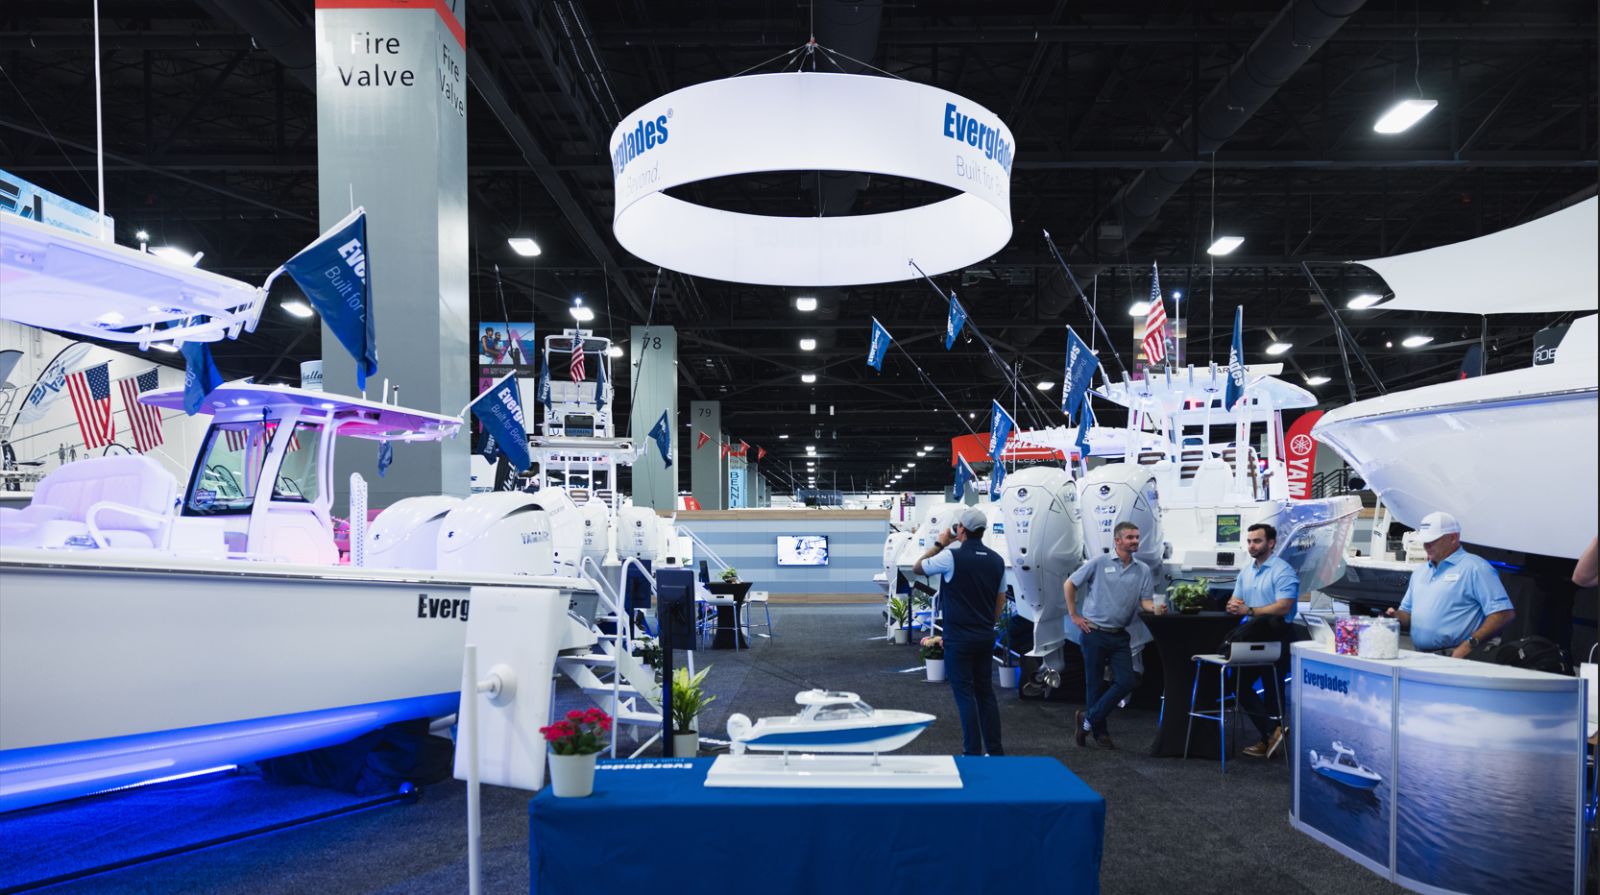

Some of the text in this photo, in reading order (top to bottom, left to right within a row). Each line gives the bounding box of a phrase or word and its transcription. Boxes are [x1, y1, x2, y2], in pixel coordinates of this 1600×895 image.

[351, 32, 400, 54] Fire
[338, 64, 414, 86] Valve
[443, 44, 459, 82] Fire
[439, 68, 464, 117] Valve
[325, 265, 352, 298] Built
[642, 336, 662, 350] 78
[1208, 365, 1250, 375] ARN
[497, 386, 526, 428] Everg
[699, 408, 712, 417] 79
[417, 594, 470, 621] Everg
[1303, 669, 1349, 695] Everglades
